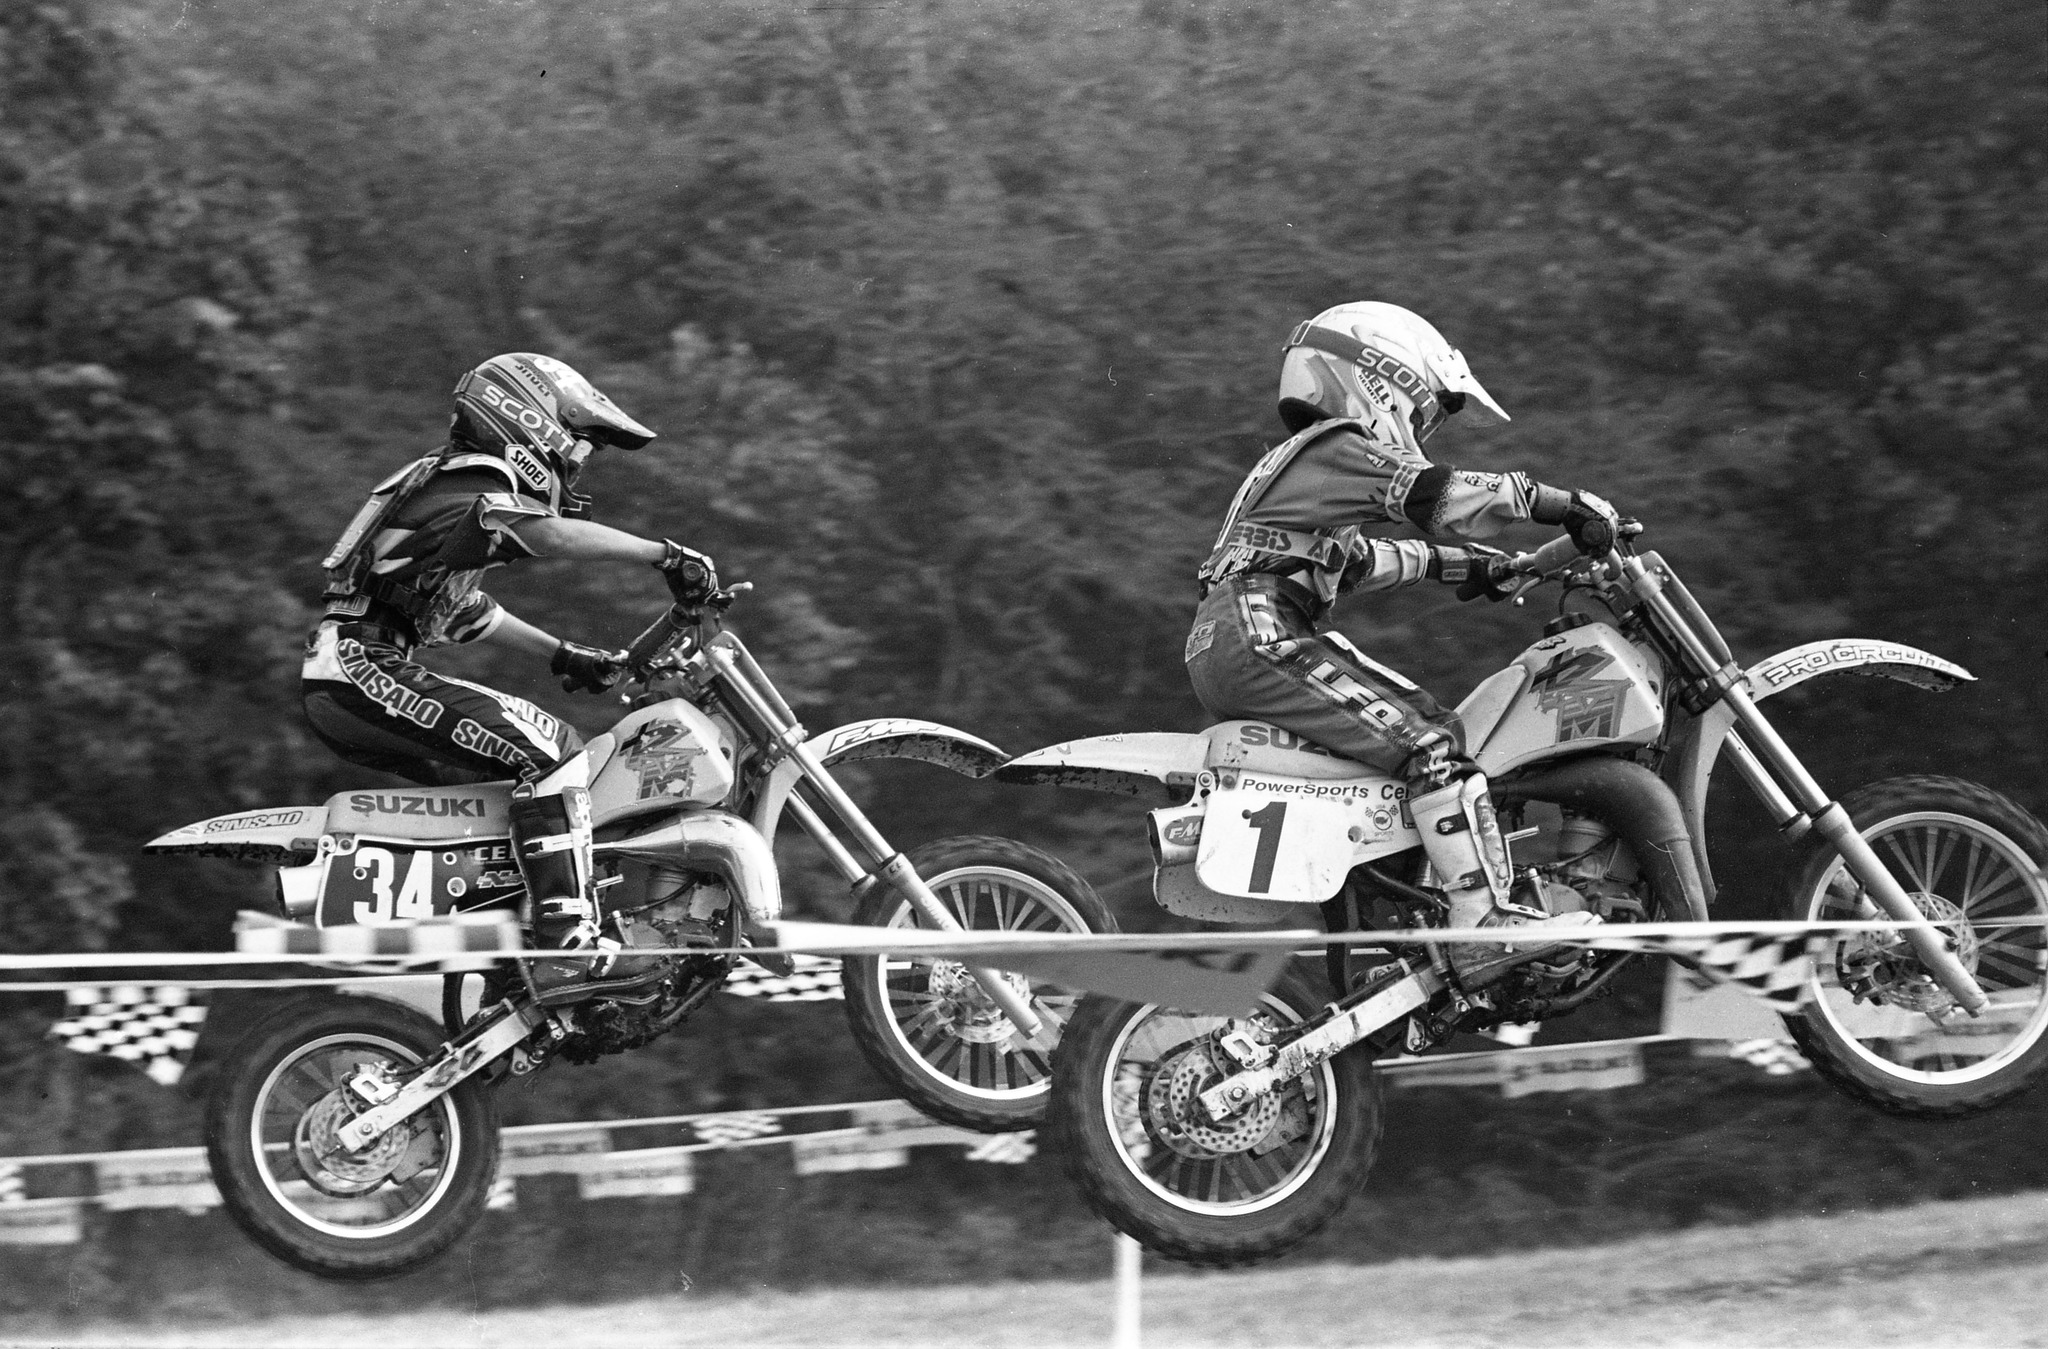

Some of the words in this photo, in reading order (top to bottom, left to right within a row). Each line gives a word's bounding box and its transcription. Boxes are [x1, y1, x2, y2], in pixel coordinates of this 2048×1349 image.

[1356, 347, 1437, 407] SCOTT
[1357, 373, 1381, 405] HELMETS
[482, 385, 574, 452] SCOTT
[510, 450, 547, 486] SHOEI
[337, 639, 443, 728] SINISALO
[1764, 651, 1829, 687] PRO
[350, 794, 485, 818] SUZUKI
[1242, 778, 1369, 799] PowerSports
[1169, 821, 1201, 839] FM
[1249, 801, 1287, 894] 1
[353, 847, 434, 924] 34
